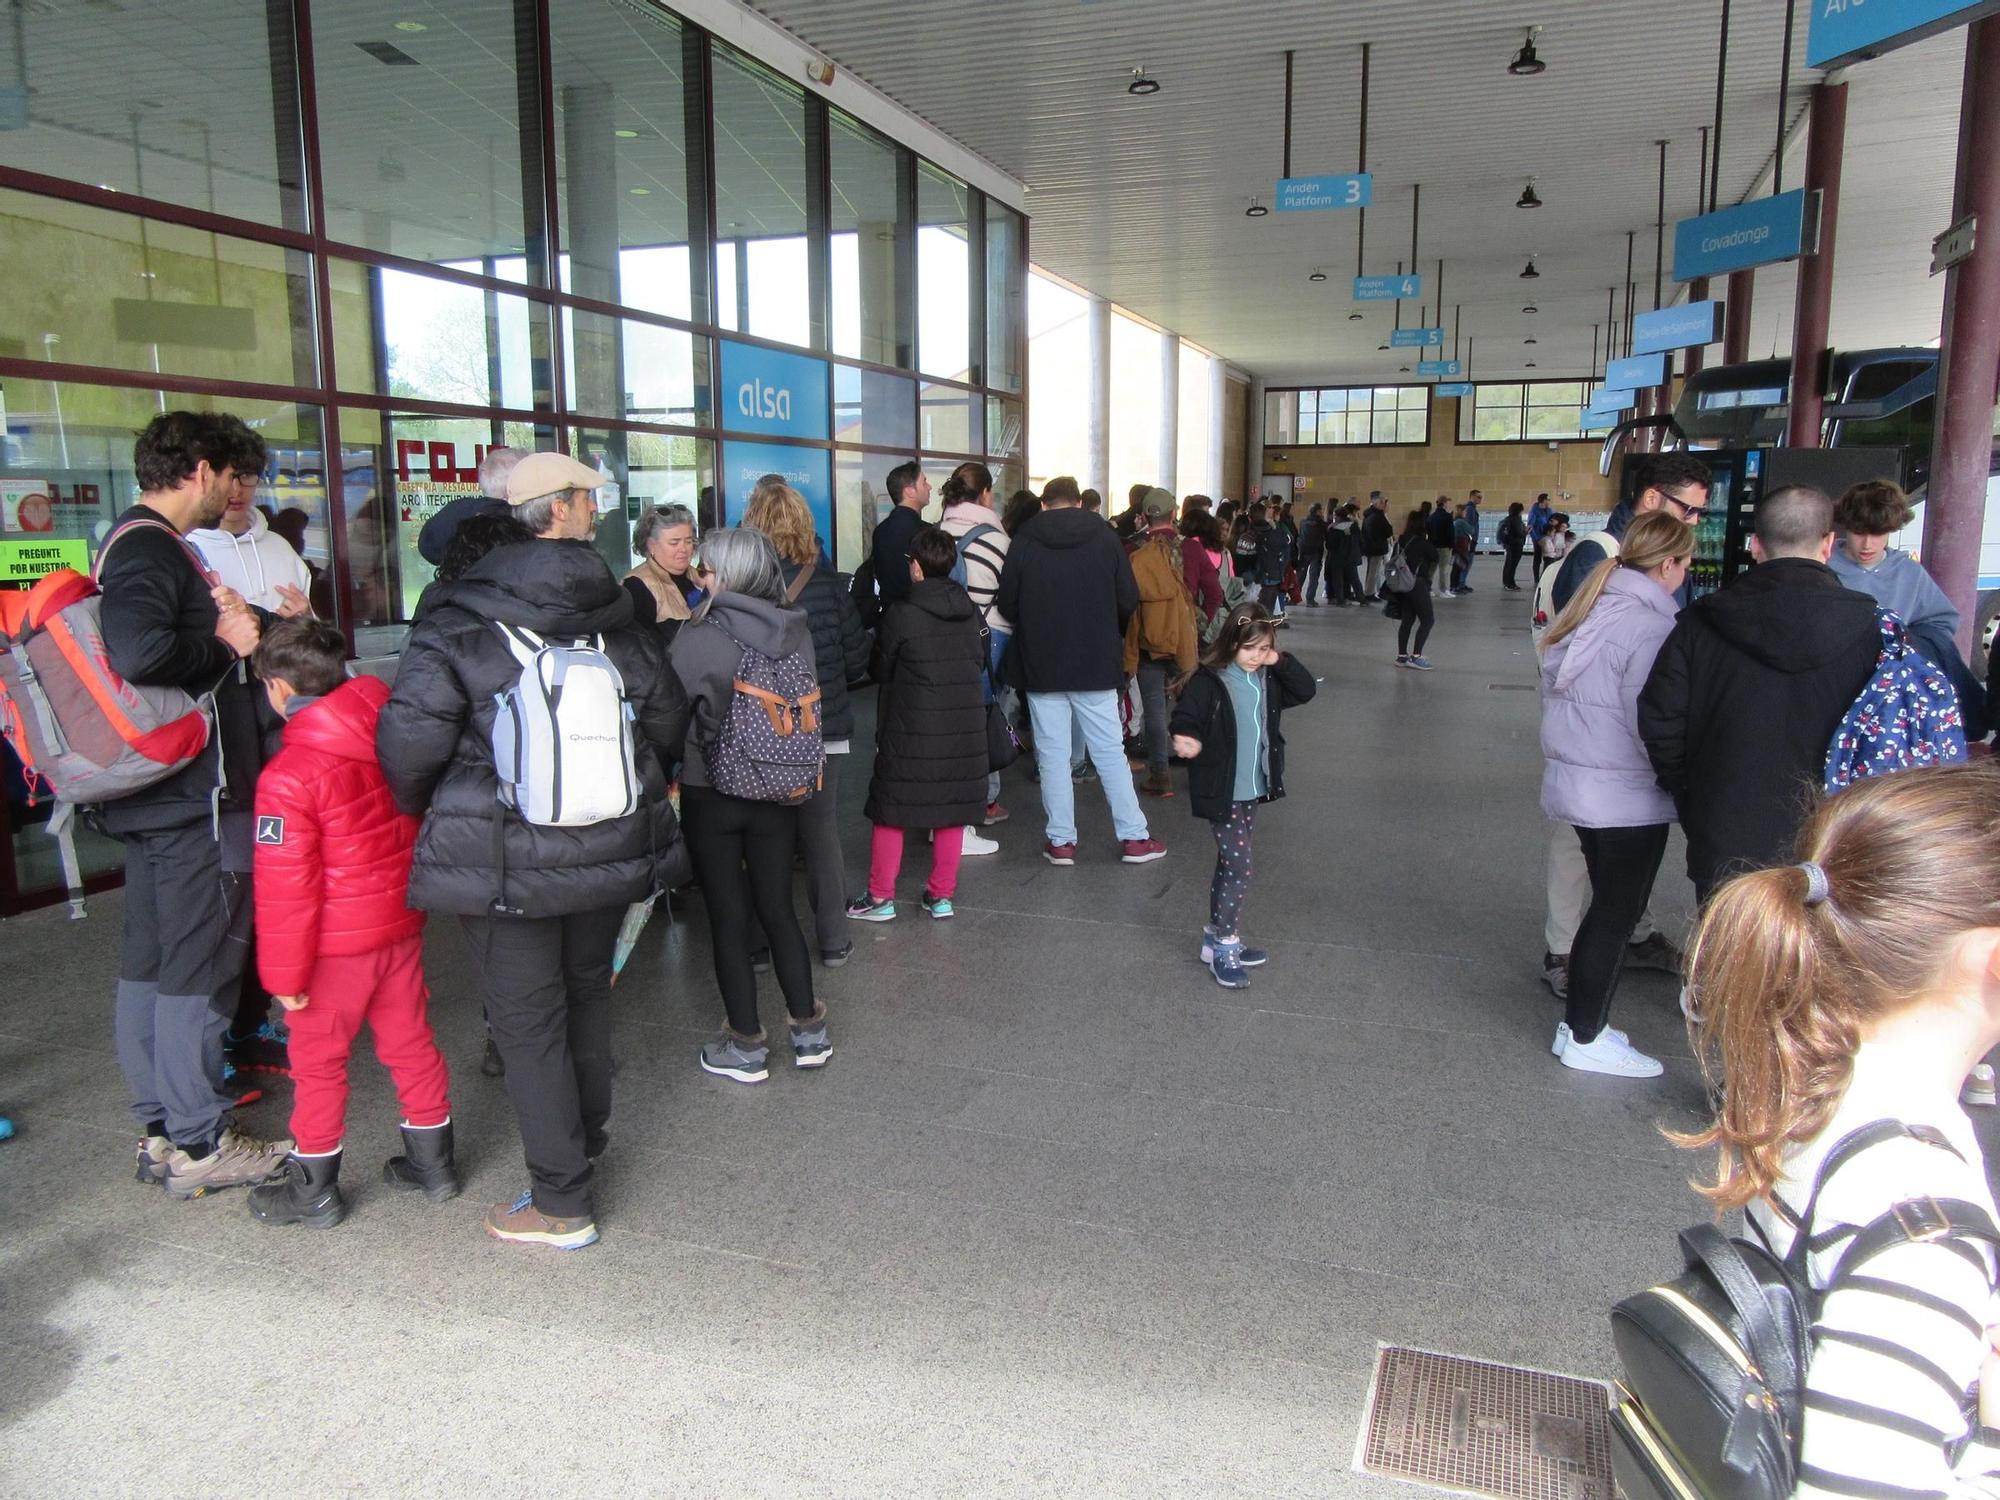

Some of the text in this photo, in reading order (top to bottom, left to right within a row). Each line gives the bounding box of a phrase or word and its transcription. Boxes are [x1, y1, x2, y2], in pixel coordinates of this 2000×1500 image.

[1285, 183, 1320, 194] Andén
[1345, 180, 1361, 203] 3
[1284, 194, 1332, 207] Platform
[1701, 224, 1769, 253] Covadonga
[1401, 279, 1413, 295] 4
[1429, 331, 1438, 344] 5
[1447, 362, 1456, 374] 6
[1462, 385, 1469, 395] 7
[738, 378, 791, 420] alsa
[18, 548, 61, 560] PREGUNTE
[10, 561, 71, 575] POR NUESTROS
